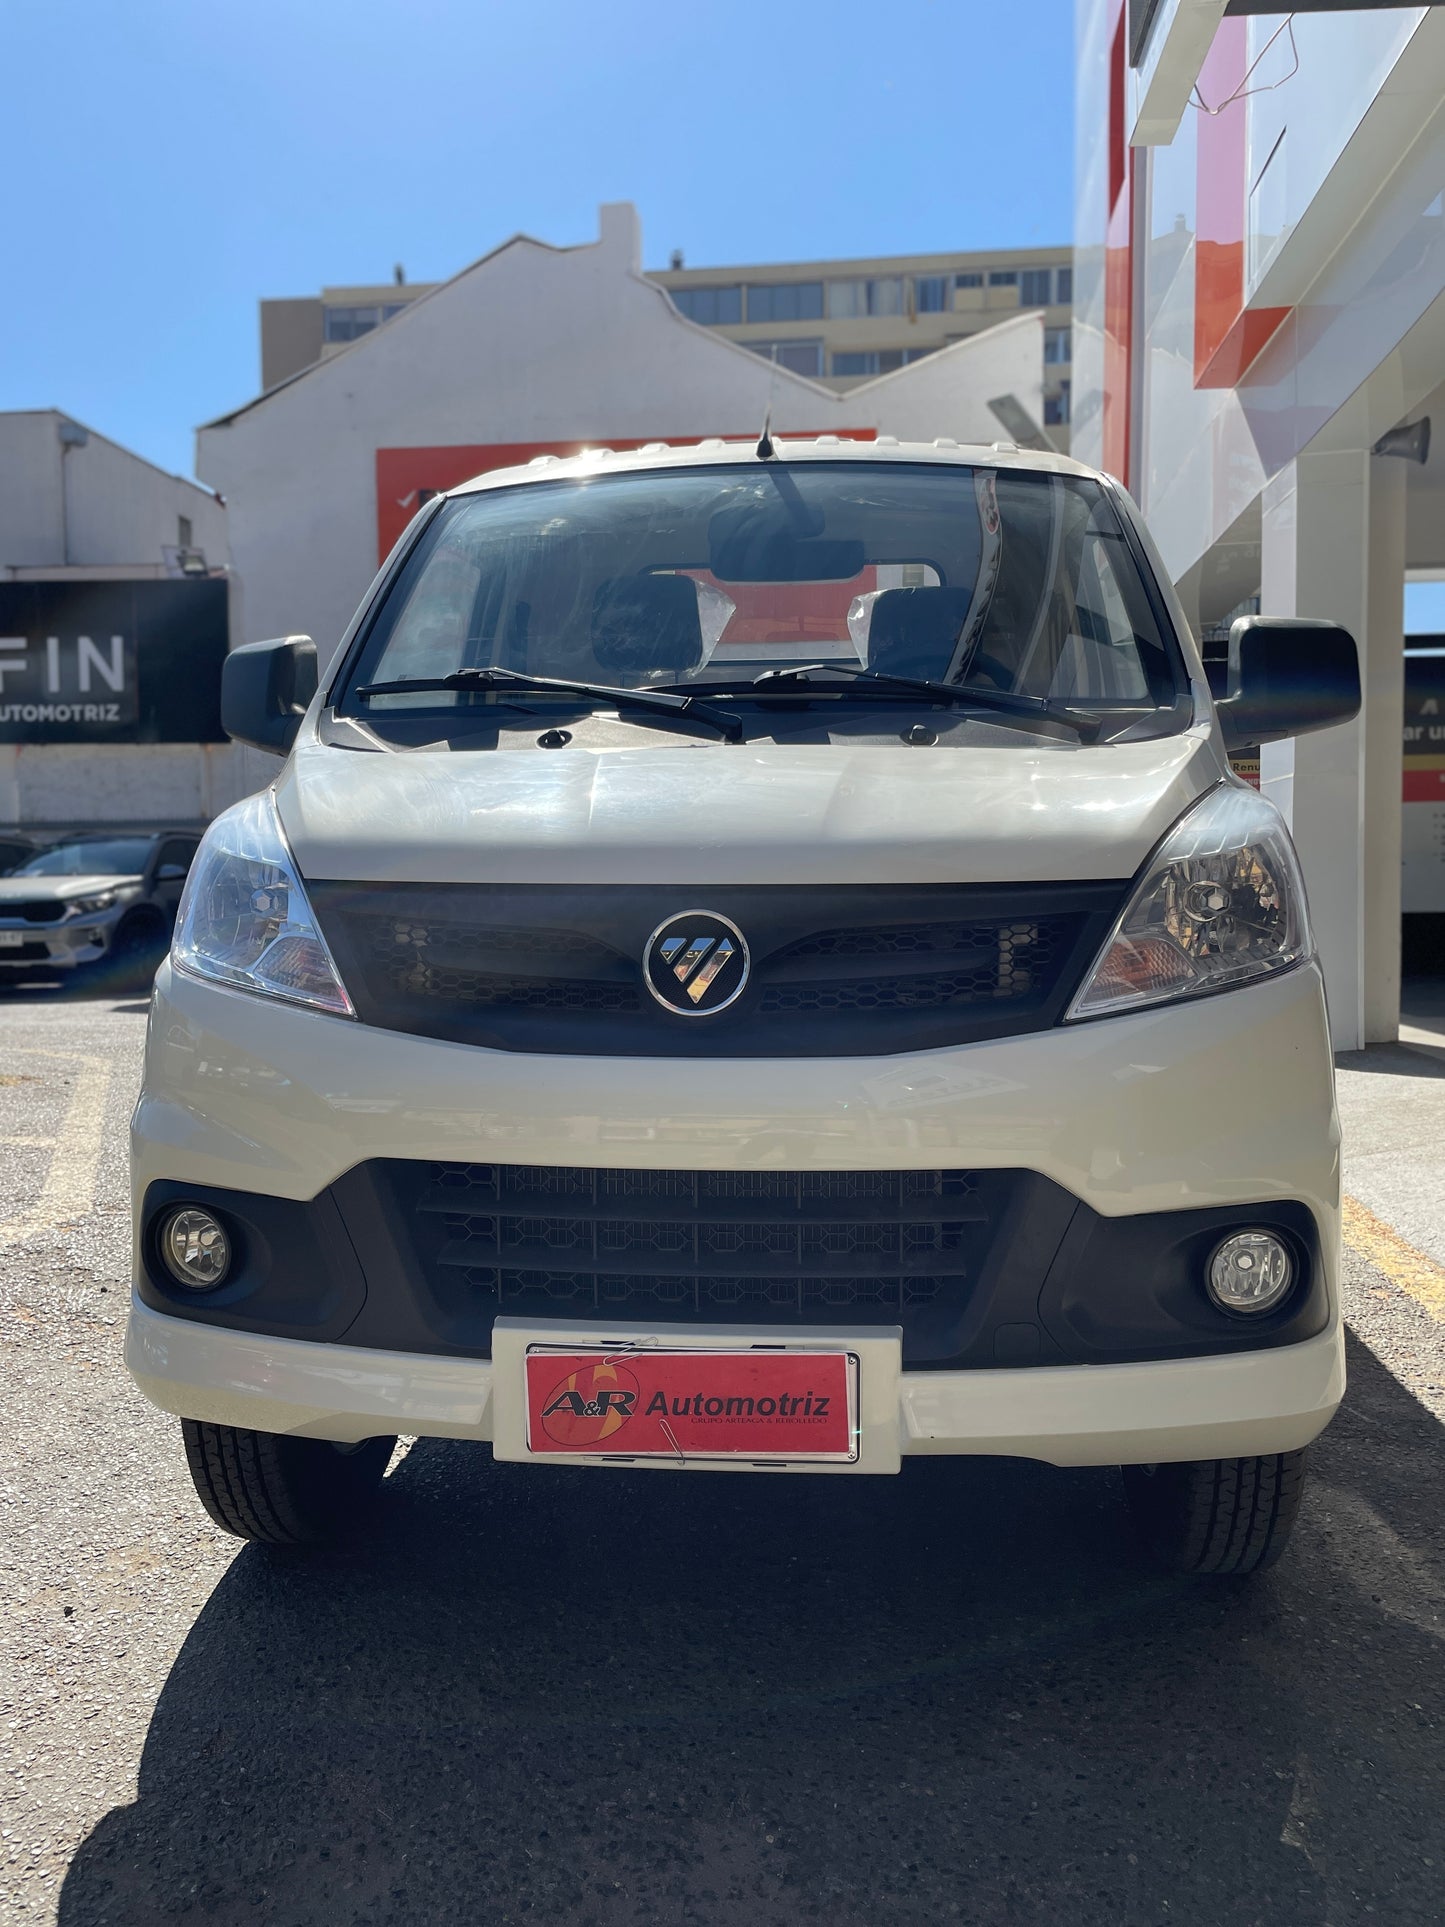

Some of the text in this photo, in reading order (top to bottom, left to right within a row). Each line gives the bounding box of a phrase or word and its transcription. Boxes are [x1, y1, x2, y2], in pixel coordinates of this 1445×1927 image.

[541, 1390, 831, 1418] A&R Automotriz
[690, 1417, 723, 1425] GRUPO
